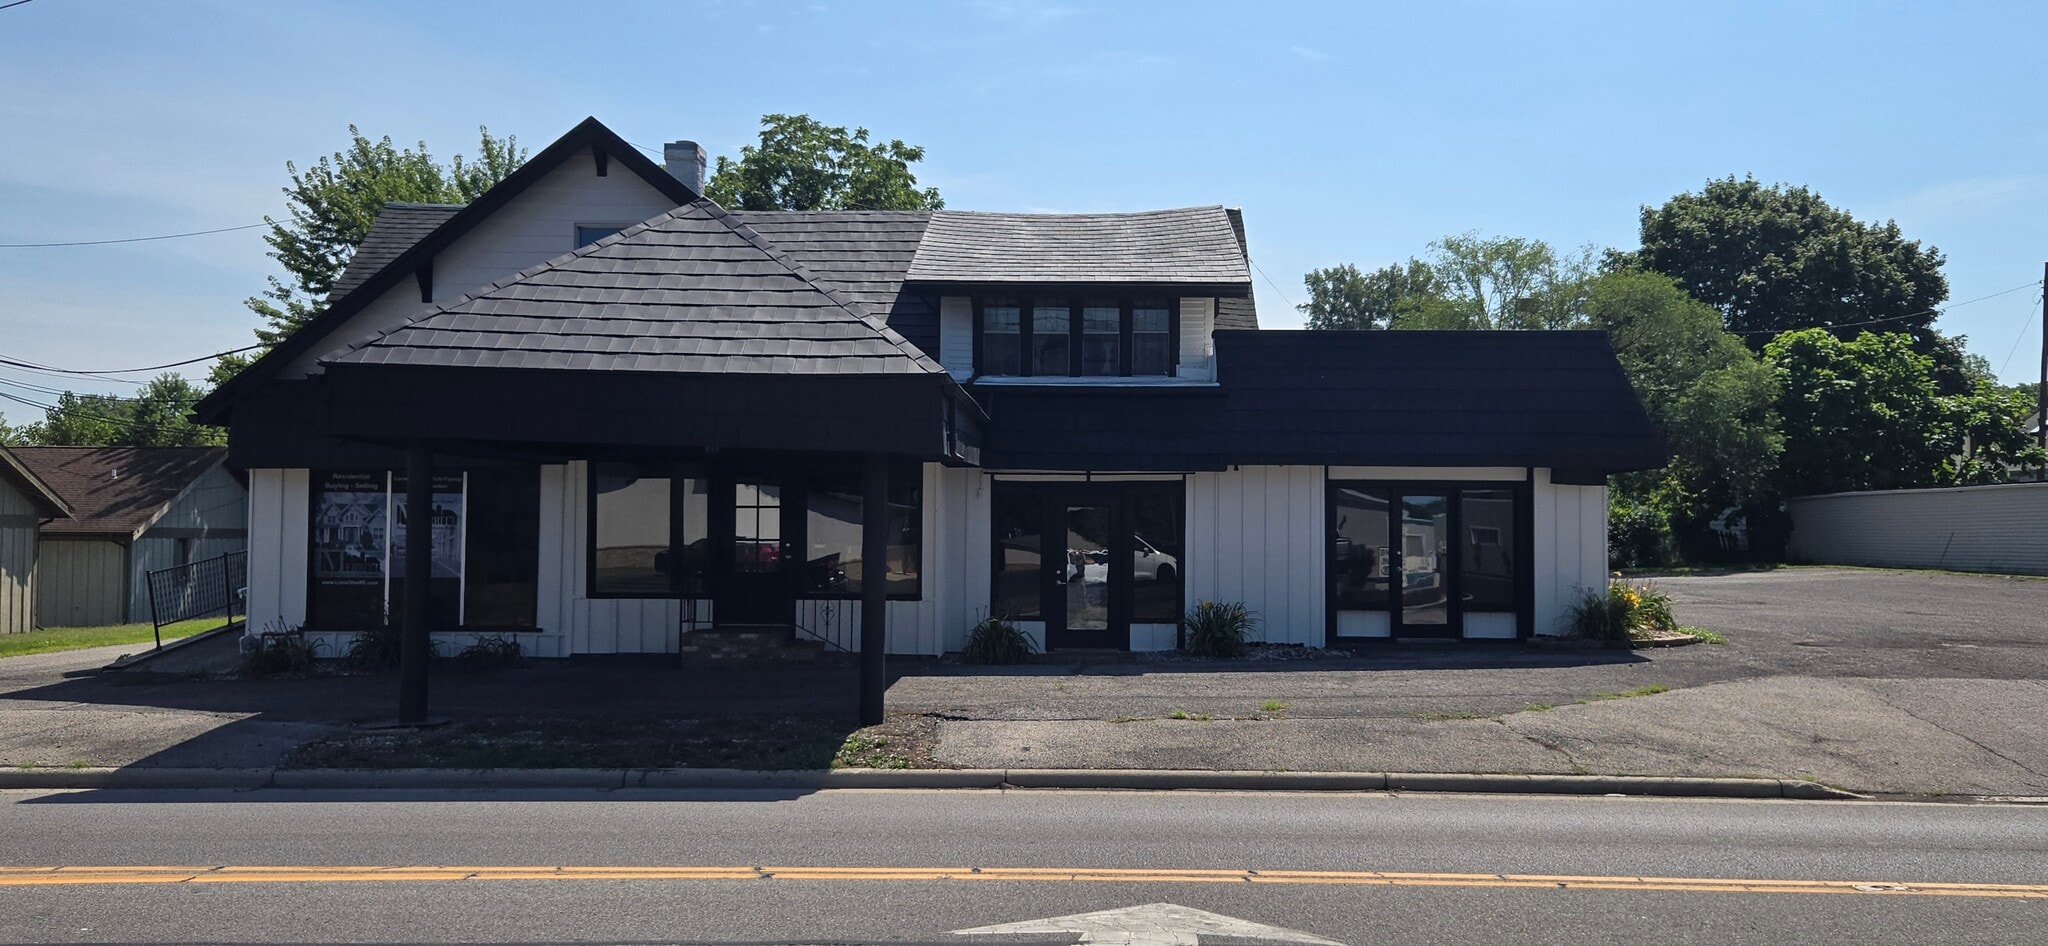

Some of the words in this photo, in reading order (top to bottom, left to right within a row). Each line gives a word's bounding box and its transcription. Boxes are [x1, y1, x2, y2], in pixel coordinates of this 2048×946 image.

[332, 472, 371, 480] Residential
[324, 482, 349, 490] Buying
[355, 482, 379, 490] Selling
